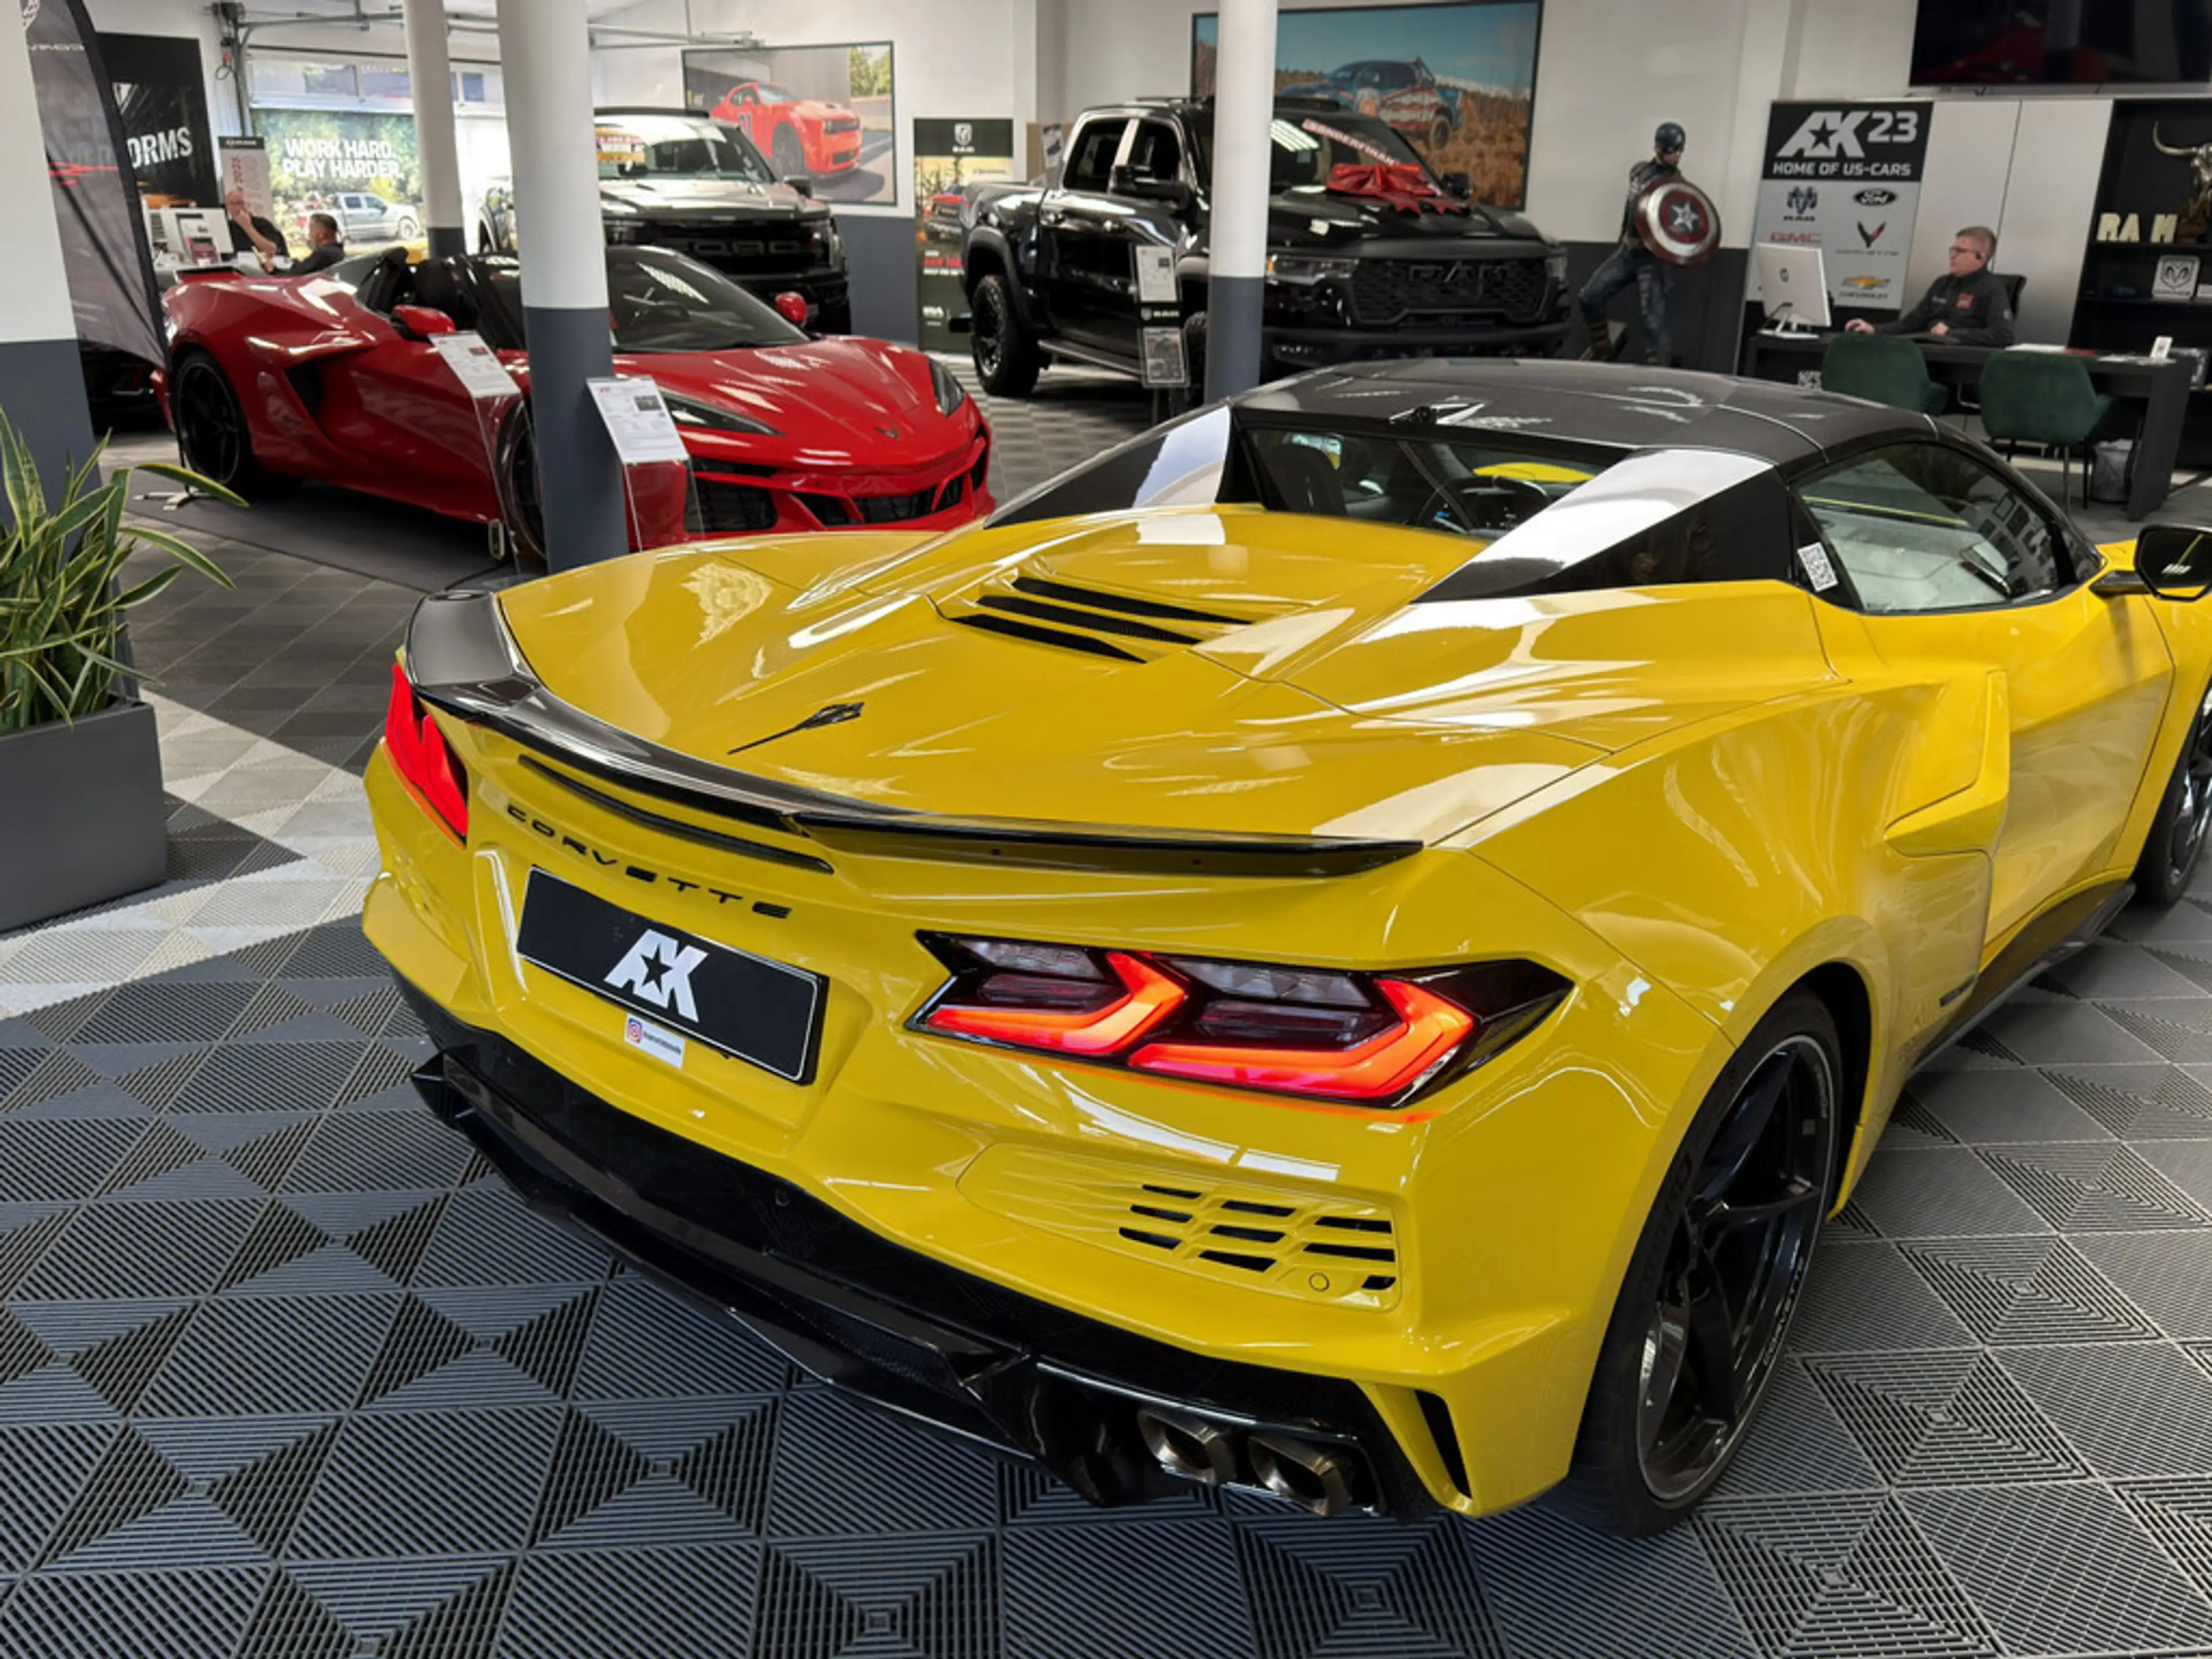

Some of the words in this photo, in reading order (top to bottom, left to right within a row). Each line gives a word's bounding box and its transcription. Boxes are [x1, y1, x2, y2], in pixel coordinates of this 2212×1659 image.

[1867, 111, 1919, 142] 23
[284, 138, 340, 158] WORK
[344, 139, 396, 159] HARD.
[282, 158, 327, 178] PLAY
[1772, 161, 1815, 175] HOME
[1819, 162, 1839, 175] OF
[1844, 163, 1911, 177] US-CARS
[1771, 232, 1822, 244] GMC
[507, 804, 793, 920] CORVETTE
[604, 928, 710, 1023] AK
